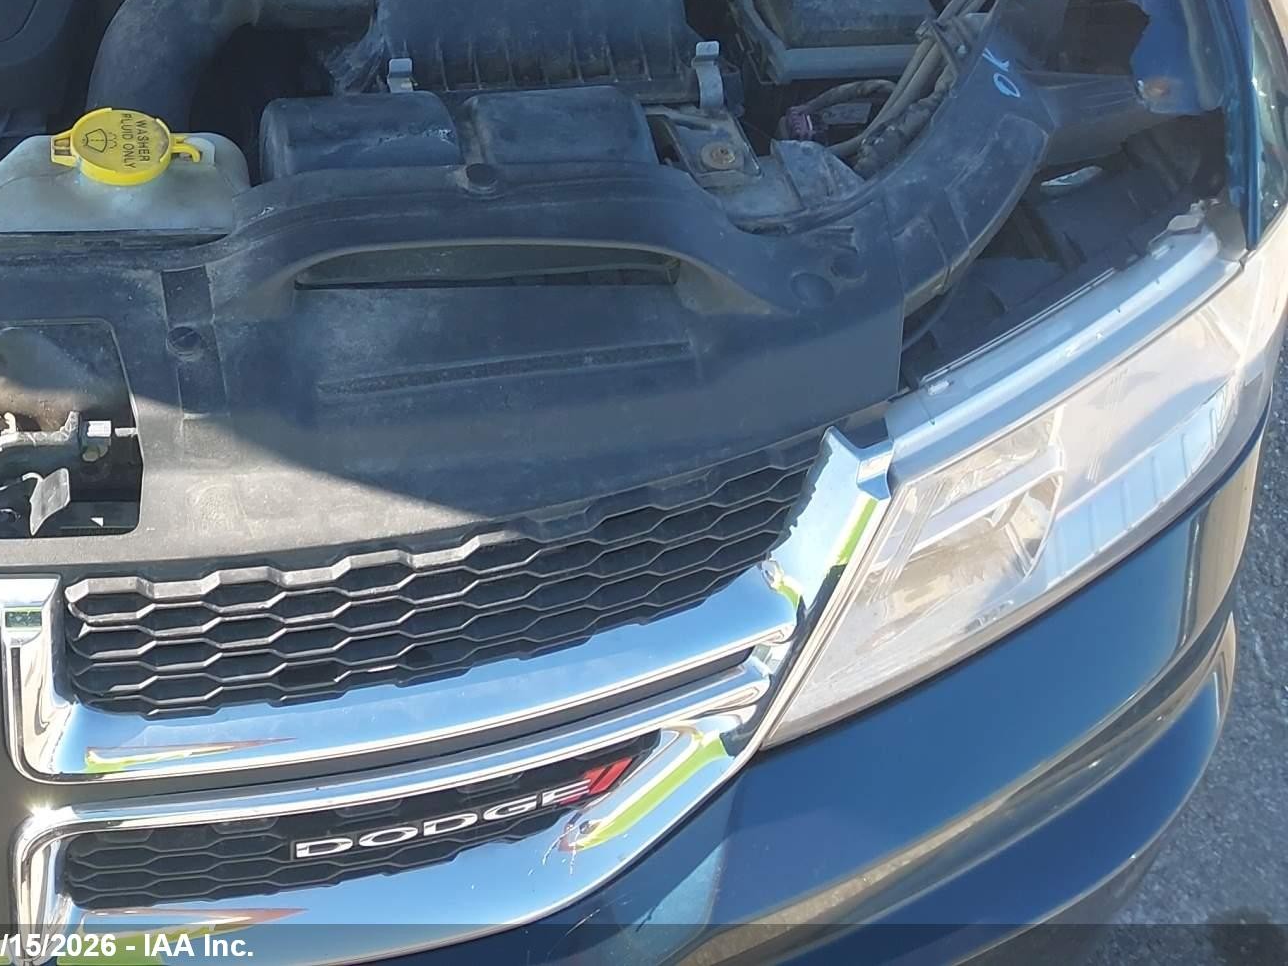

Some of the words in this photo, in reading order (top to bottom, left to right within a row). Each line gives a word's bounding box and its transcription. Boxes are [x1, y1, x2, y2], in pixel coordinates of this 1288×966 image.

[120, 113, 134, 140] FLUID
[136, 119, 150, 162] WASHER
[122, 143, 136, 169] ONLY
[295, 778, 592, 859] DODGE
